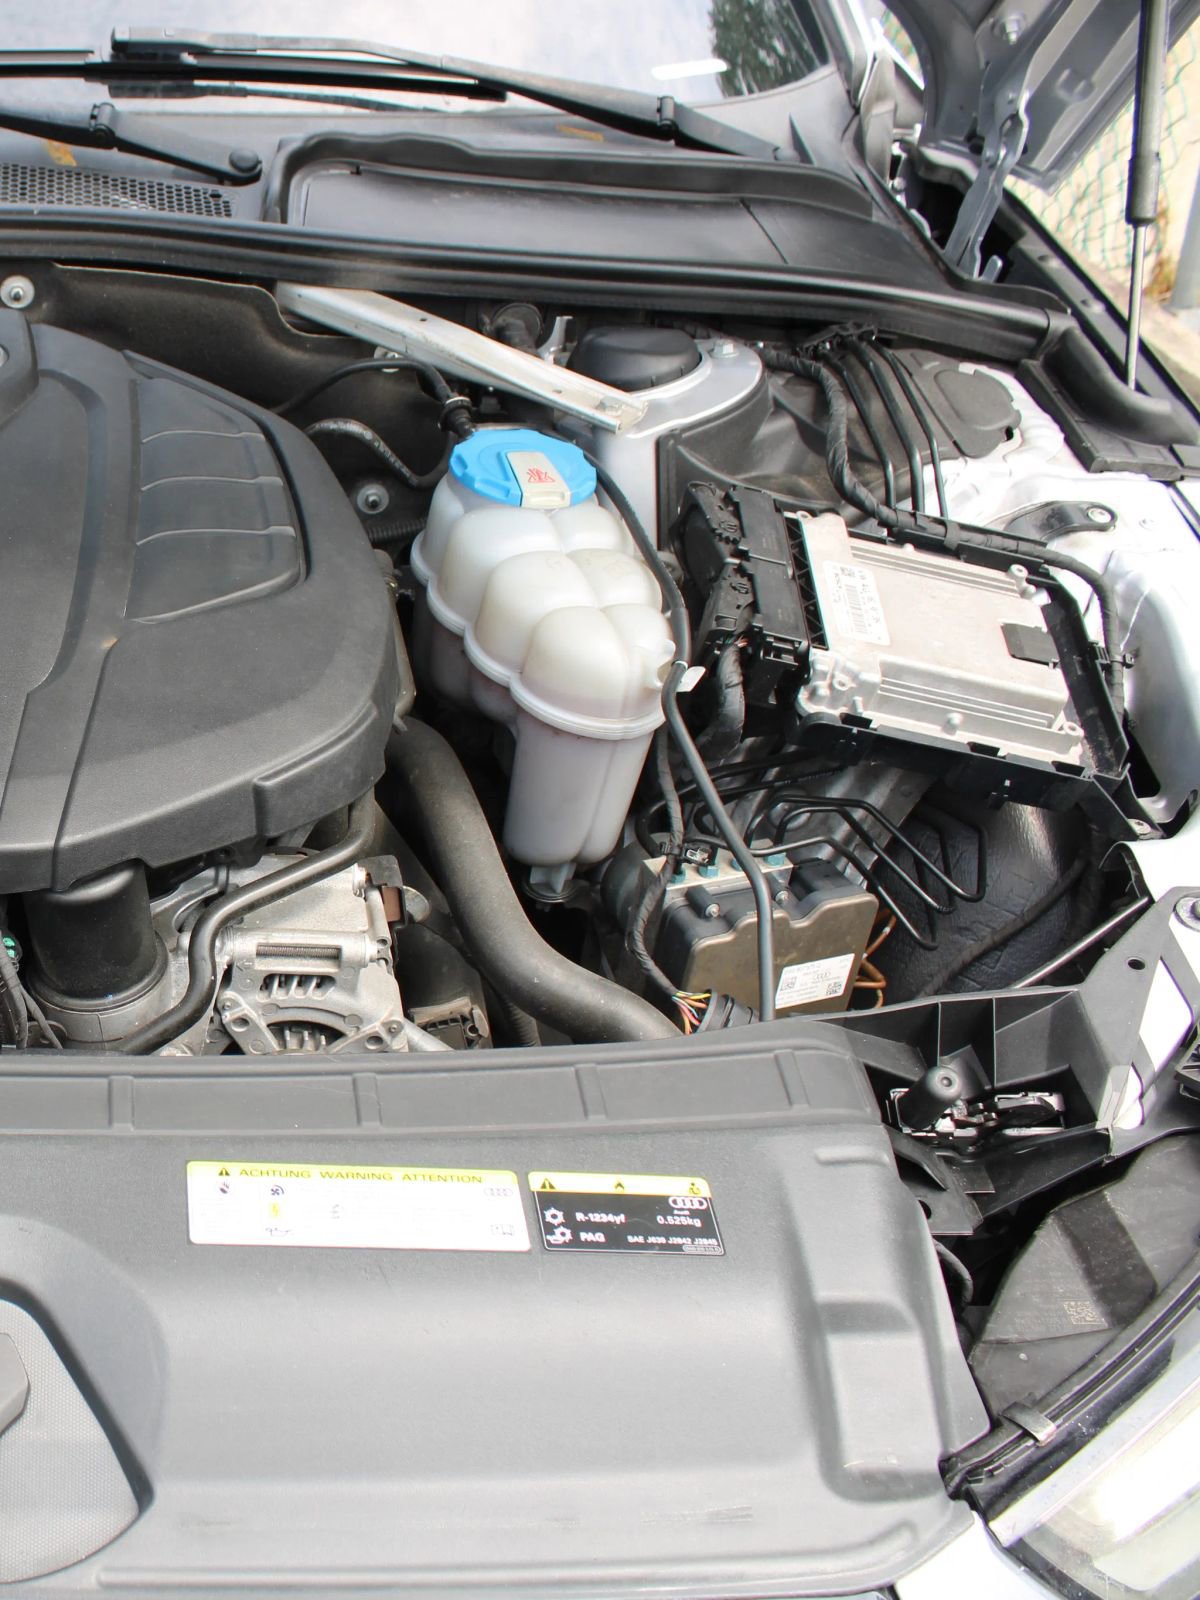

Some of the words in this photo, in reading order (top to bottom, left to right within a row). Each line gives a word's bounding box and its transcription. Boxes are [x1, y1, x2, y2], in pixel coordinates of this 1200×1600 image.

[239, 1168, 312, 1179] ACHTUNG
[319, 1171, 393, 1182] WARNING
[400, 1173, 483, 1184] ATTENTION
[575, 1211, 626, 1225] R-1234yf
[656, 1215, 703, 1228] 0.525kg
[579, 1231, 607, 1243] PAG
[626, 1235, 645, 1244] SAE
